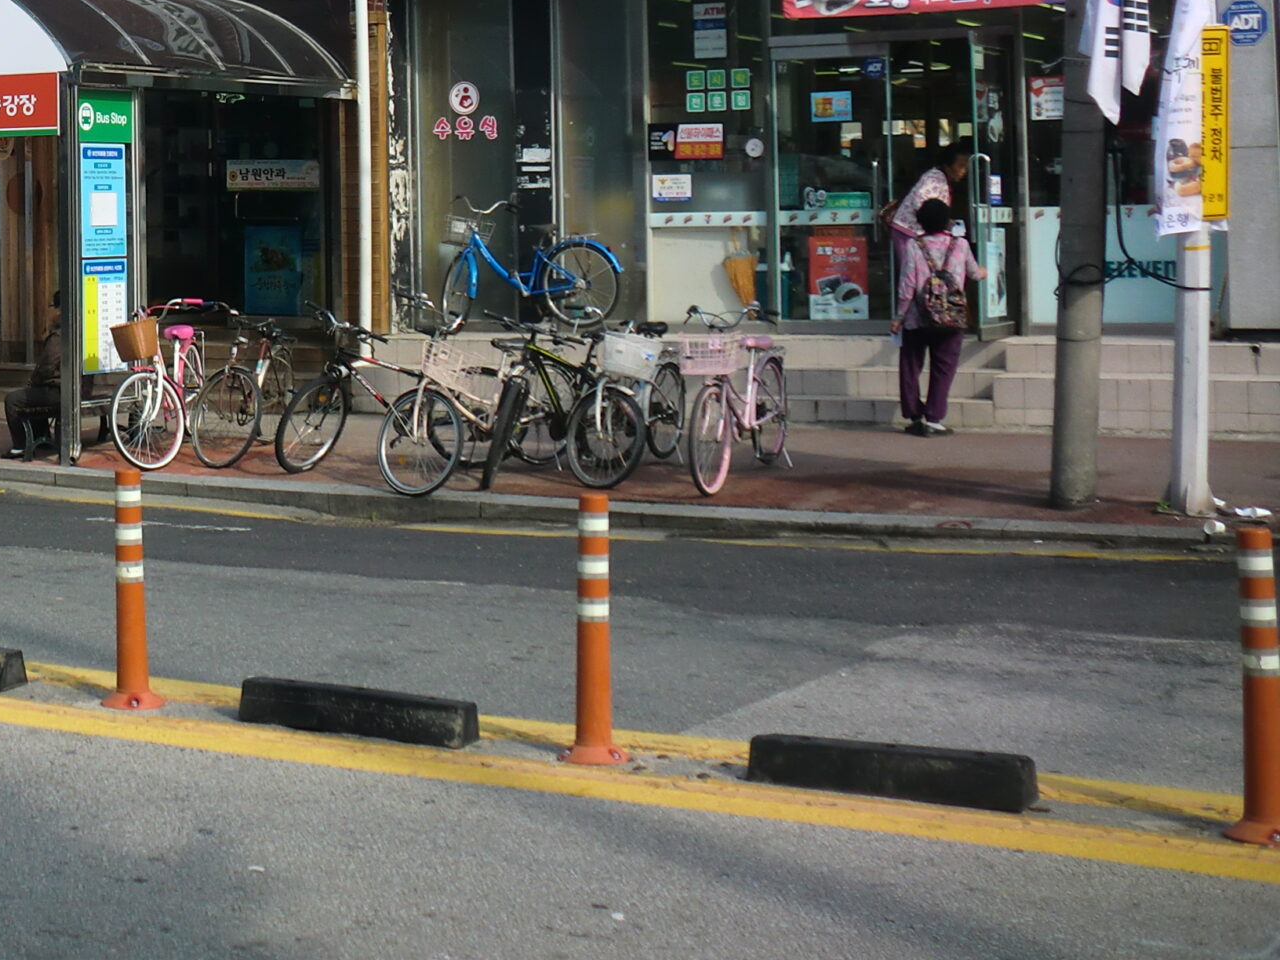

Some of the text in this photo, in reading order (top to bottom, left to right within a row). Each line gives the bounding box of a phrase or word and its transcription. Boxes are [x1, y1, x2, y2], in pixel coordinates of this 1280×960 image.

[1230, 14, 1262, 29] ADT
[96, 112, 127, 126] Bus Stop
[239, 168, 286, 181] 남원안과
